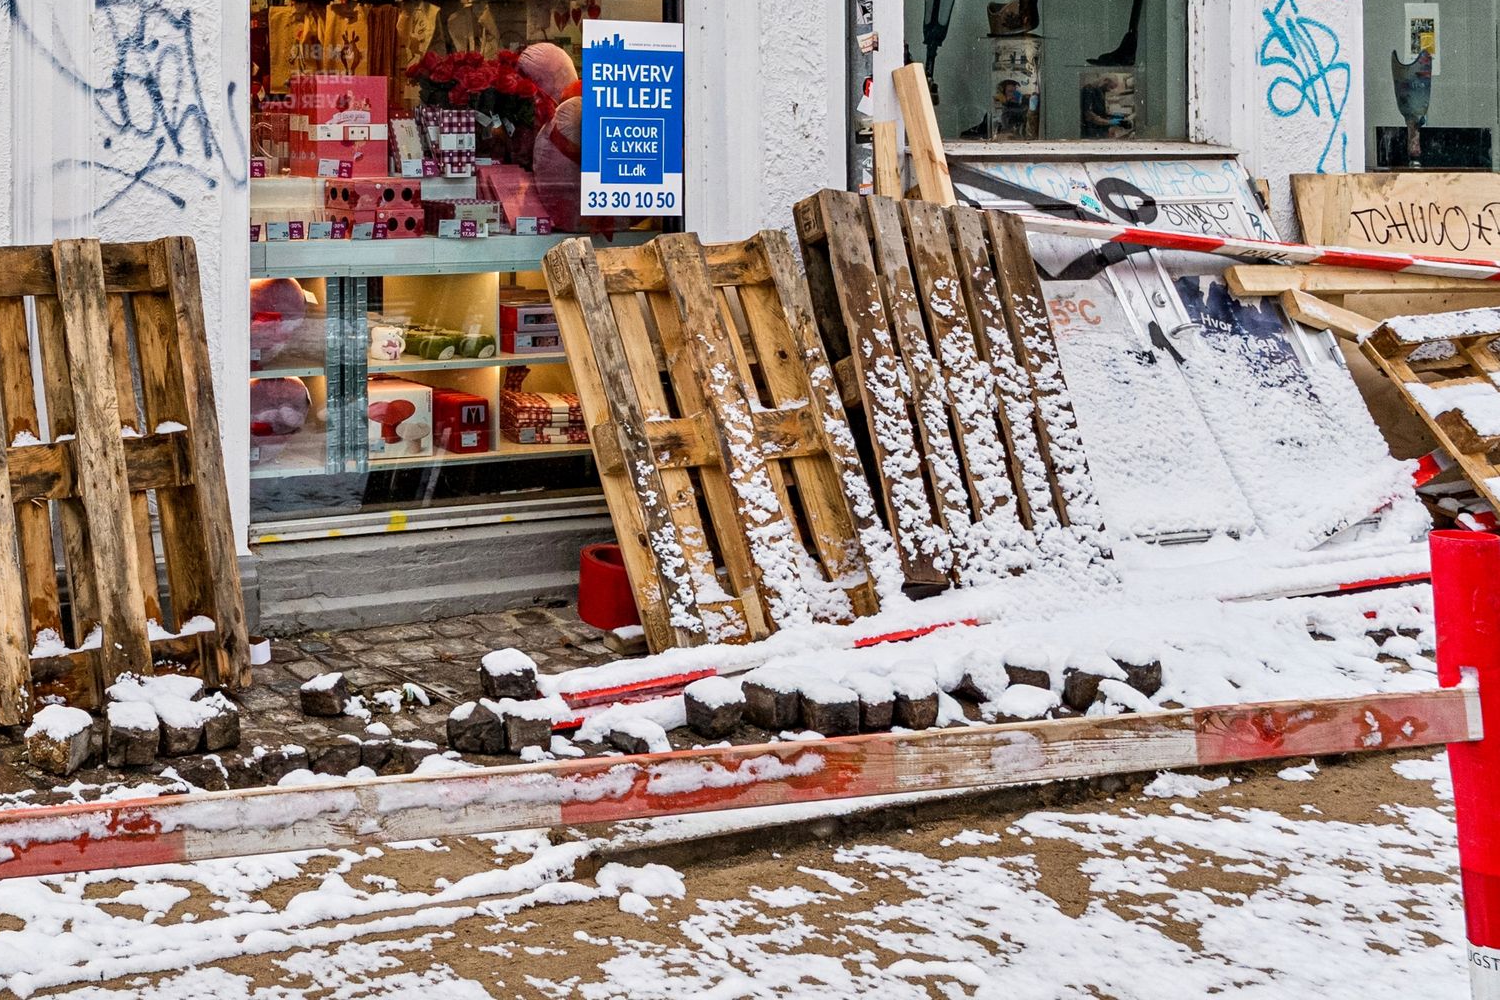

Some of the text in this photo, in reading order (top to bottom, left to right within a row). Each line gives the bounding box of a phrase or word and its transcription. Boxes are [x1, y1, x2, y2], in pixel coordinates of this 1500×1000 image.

[591, 62, 674, 83] ERHVERV
[592, 86, 673, 109] TIL LEJE
[605, 125, 659, 139] LA COUR
[610, 140, 658, 154] & LYKKE
[618, 163, 646, 177] LL.dk
[588, 191, 675, 209] 33 30 10 50
